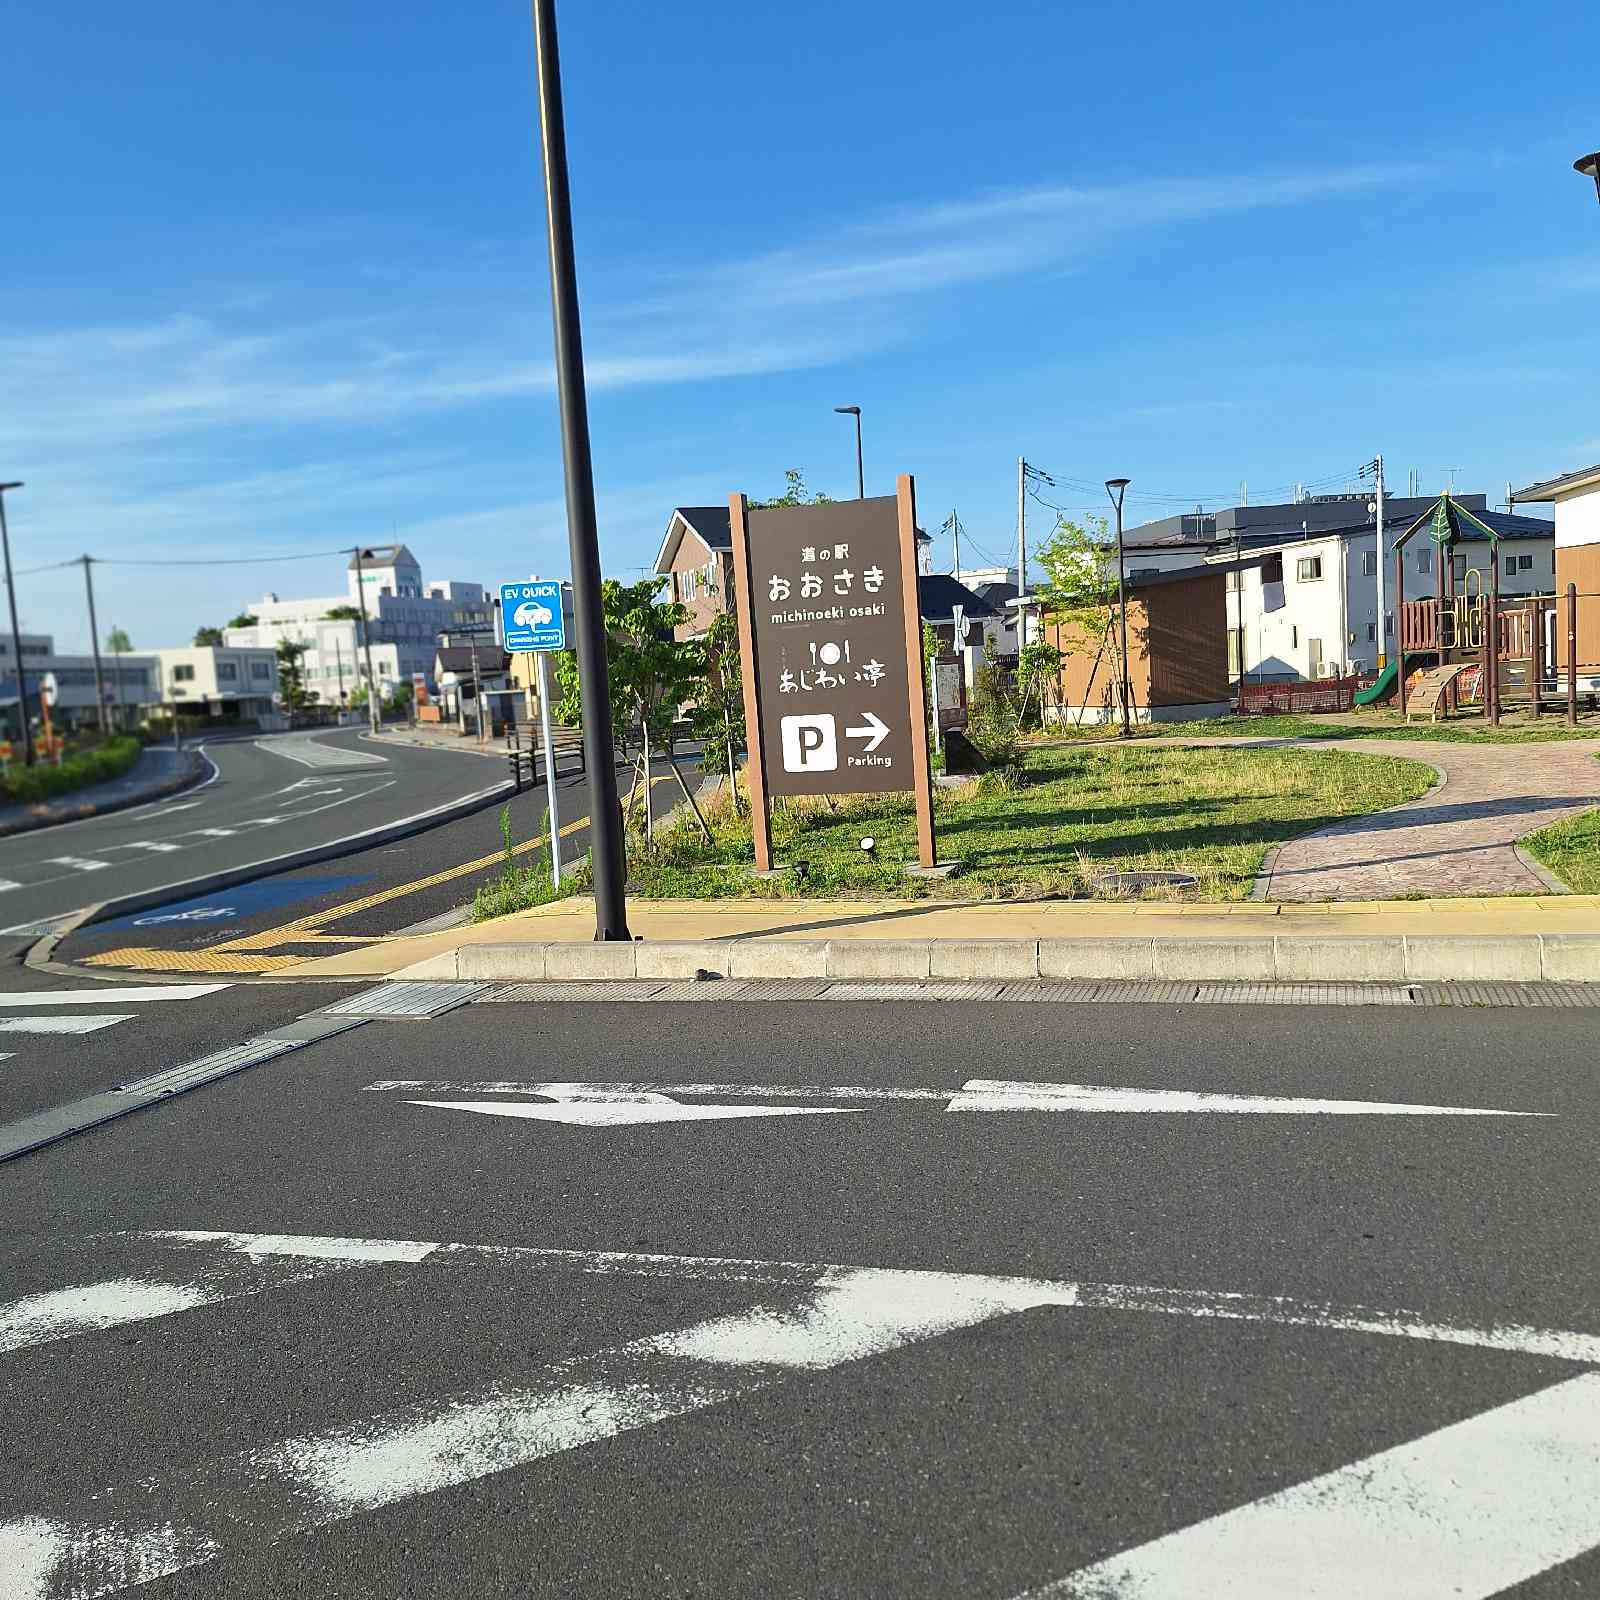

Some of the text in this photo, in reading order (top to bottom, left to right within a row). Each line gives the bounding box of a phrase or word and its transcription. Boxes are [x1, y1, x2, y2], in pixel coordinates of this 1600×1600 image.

[801, 543, 849, 562] 道の駅
[505, 585, 557, 600] EV QUICK
[768, 565, 885, 602] おおさき
[771, 603, 885, 624] michinoeki osaki
[779, 658, 886, 693] あじわい亭
[798, 726, 824, 764] P
[847, 754, 892, 768] Parking
